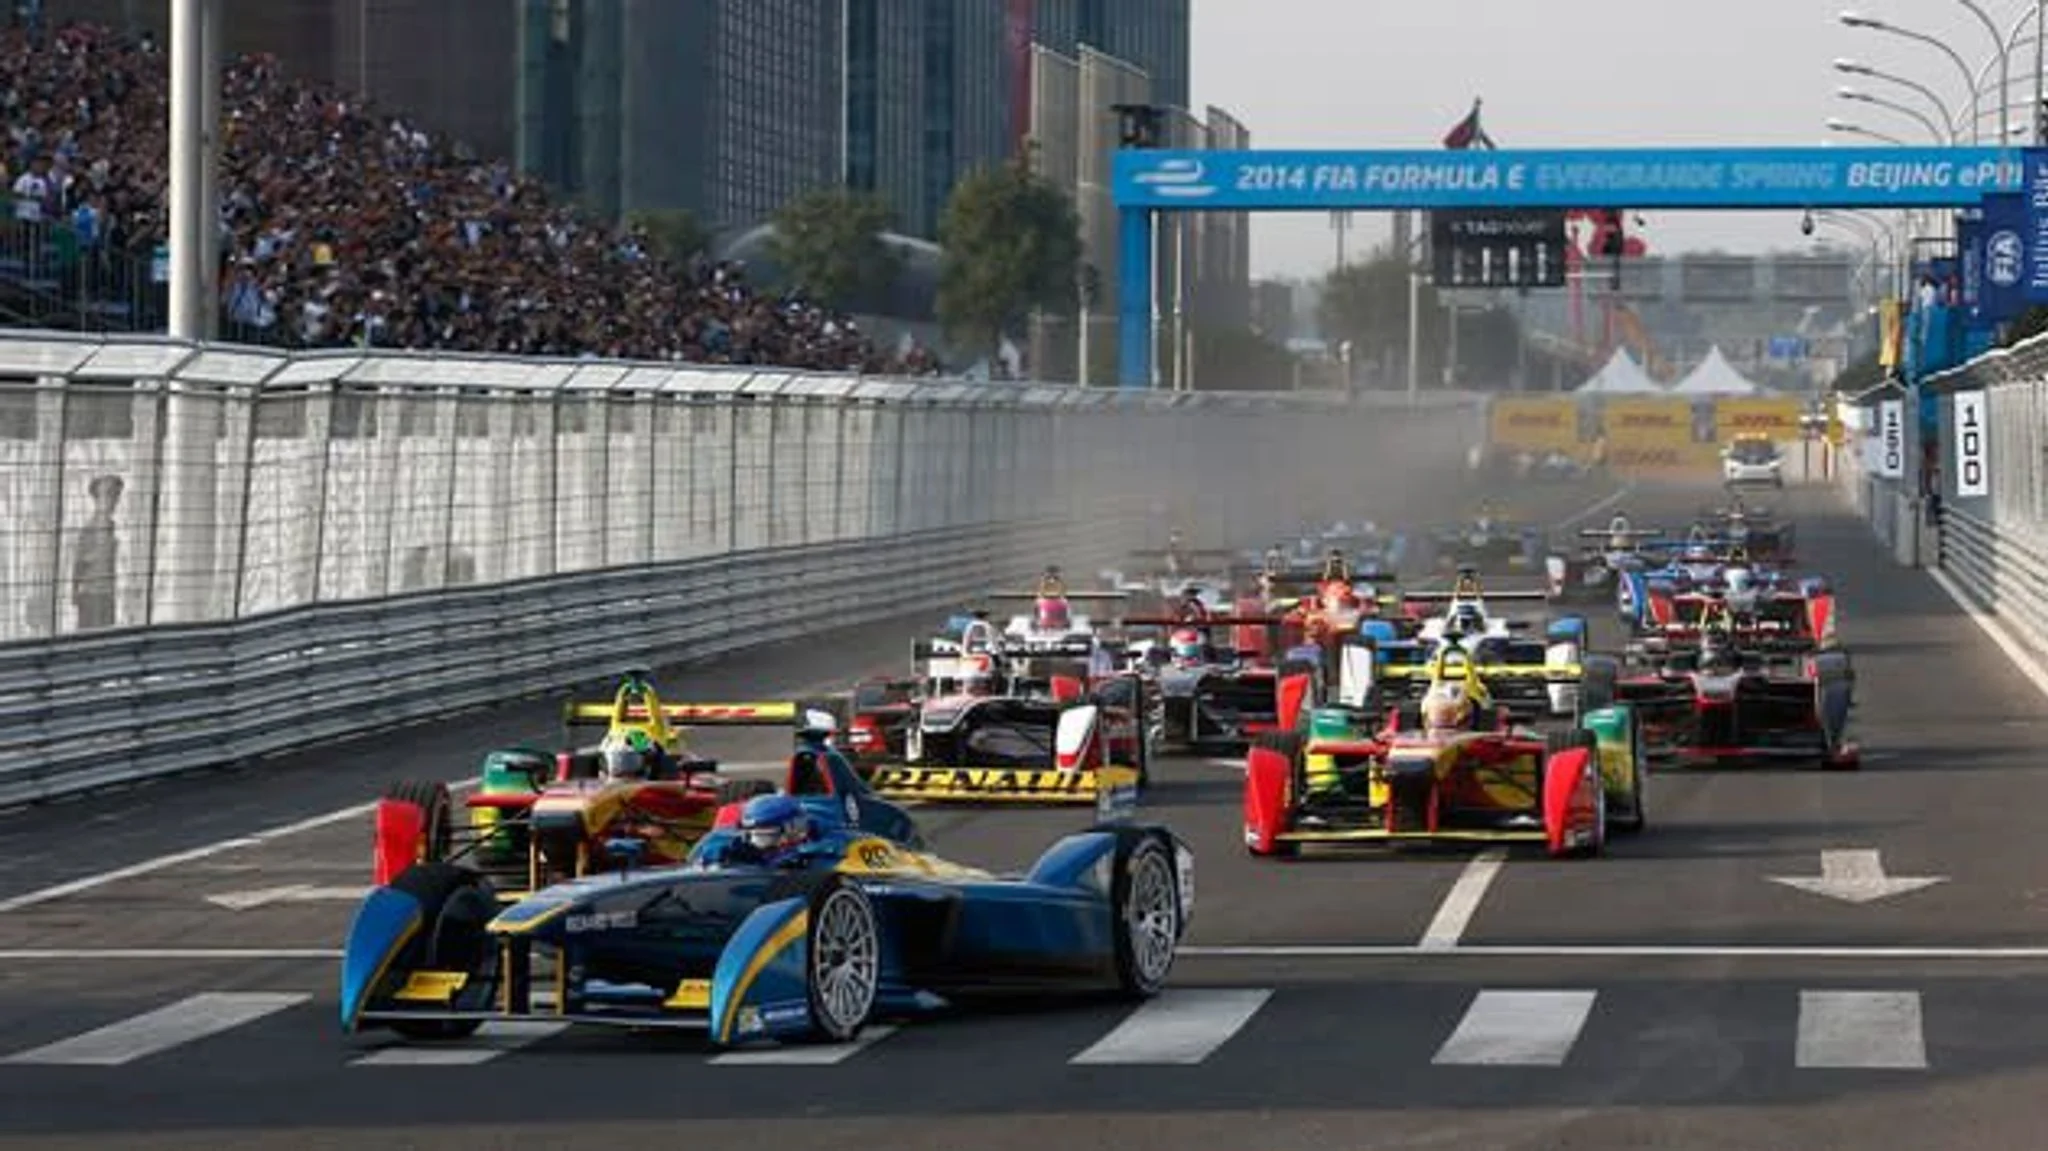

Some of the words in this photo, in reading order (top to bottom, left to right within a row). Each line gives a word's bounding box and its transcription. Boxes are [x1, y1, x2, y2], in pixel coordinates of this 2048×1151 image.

[1236, 163, 1306, 190] 2014
[1313, 164, 1357, 191] FIA
[1365, 164, 1499, 191] FORMULA
[1508, 163, 1526, 190] E
[1731, 162, 1837, 189] SPRING
[1848, 161, 1951, 193] BEIJING
[1957, 161, 2024, 188] ePRI
[1992, 235, 2017, 283] FIA
[1963, 404, 1981, 486] 100
[872, 766, 1100, 793] RENAUL
